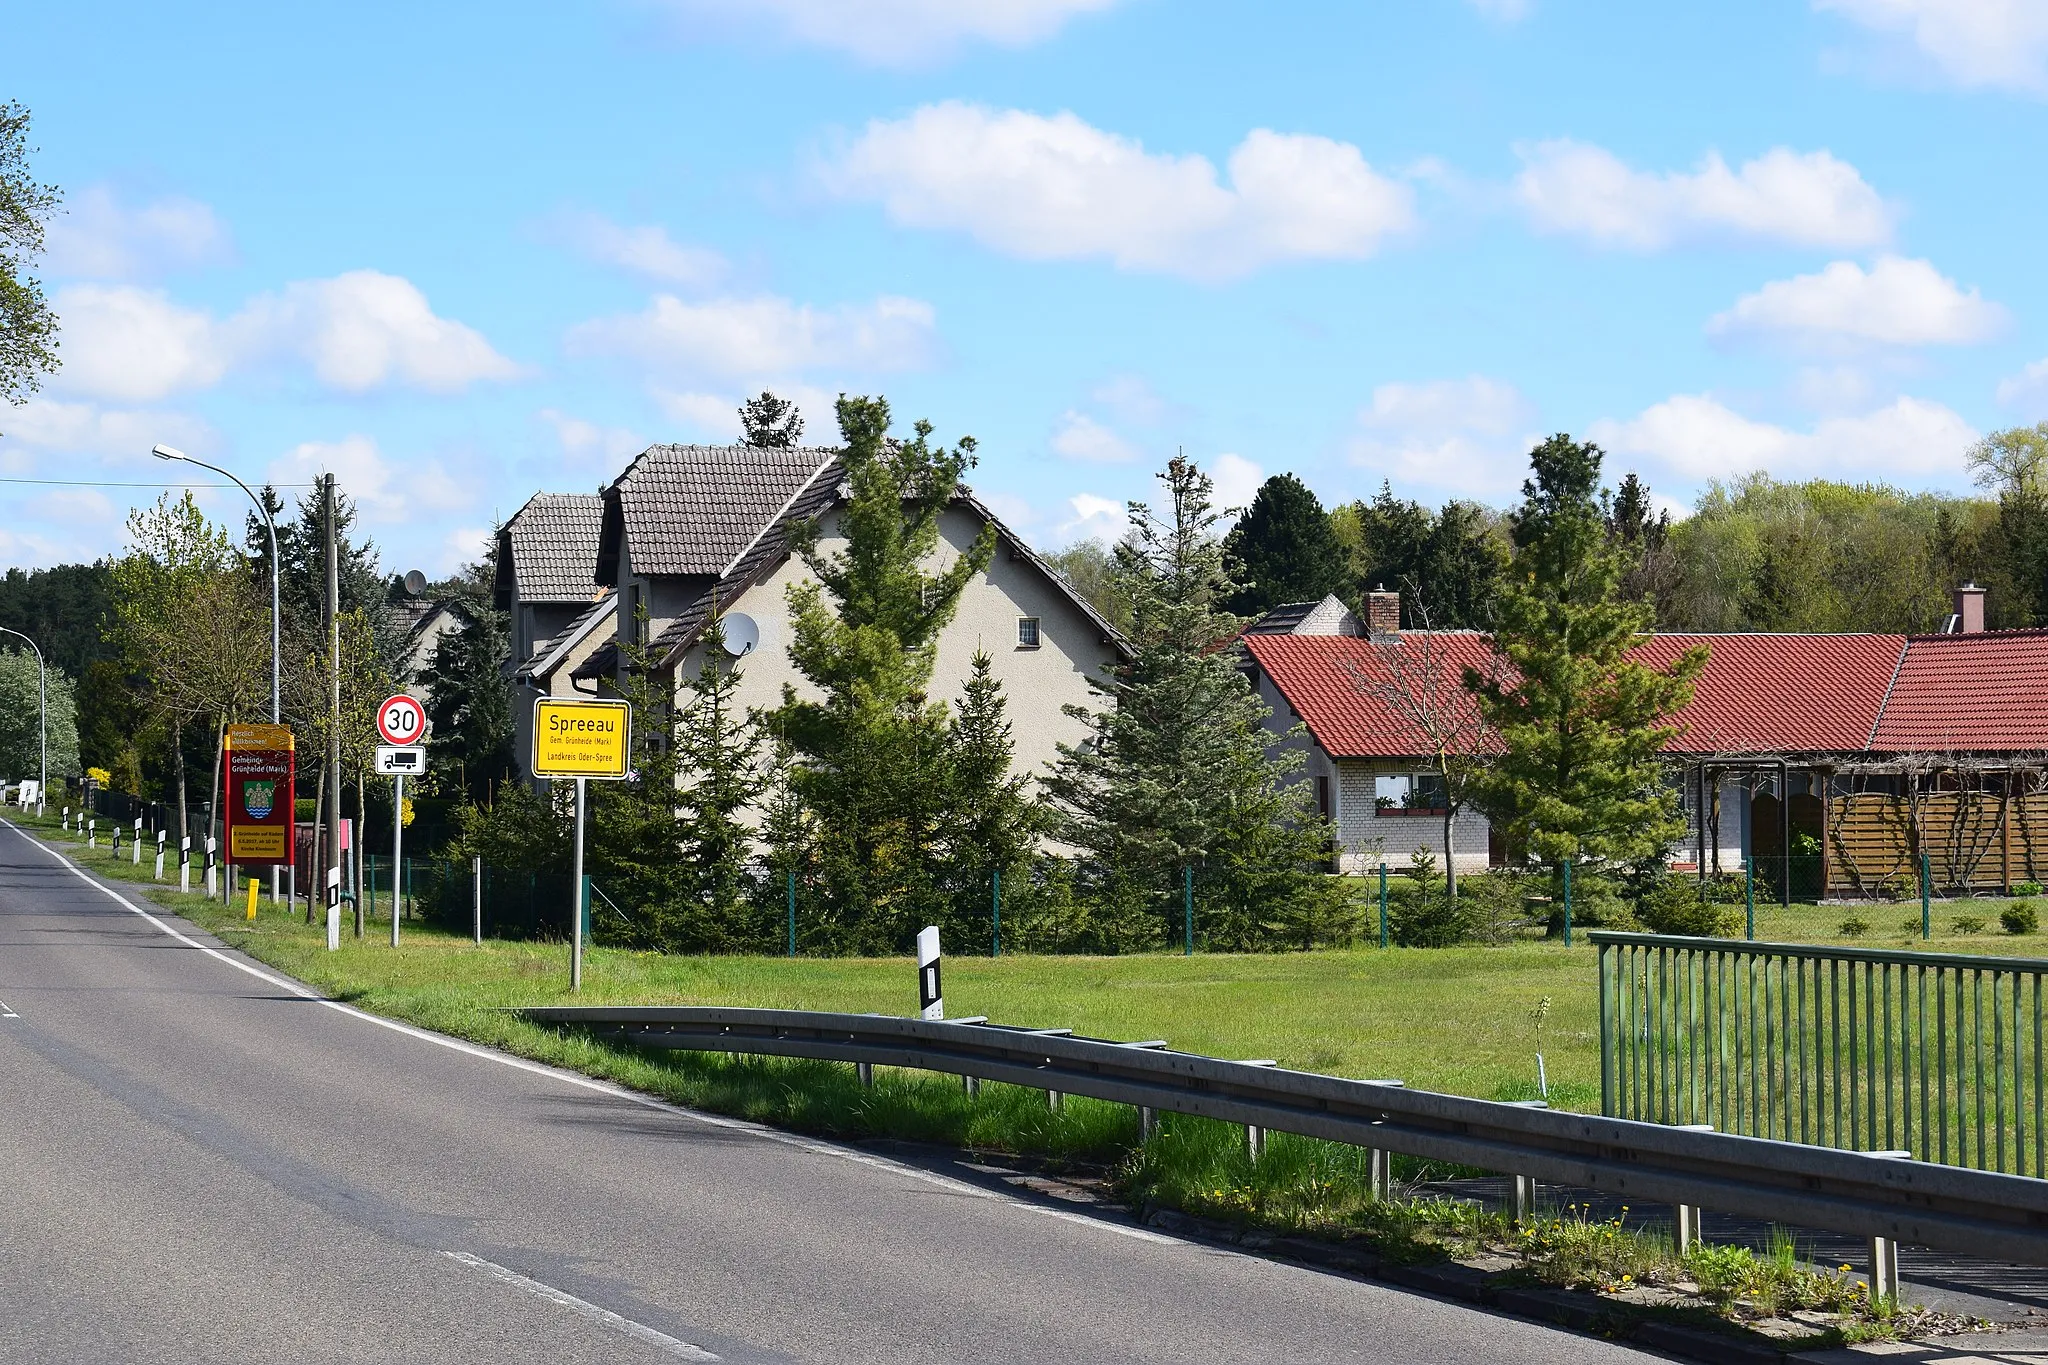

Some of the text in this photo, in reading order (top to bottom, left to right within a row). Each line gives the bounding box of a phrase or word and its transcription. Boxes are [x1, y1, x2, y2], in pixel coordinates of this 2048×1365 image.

[388, 709, 414, 731] 30
[549, 714, 614, 735] Spreeau
[550, 735, 563, 744] Gem.
[565, 736, 592, 745] Grünheide
[547, 751, 613, 762] Landkreis Oder-Spree
